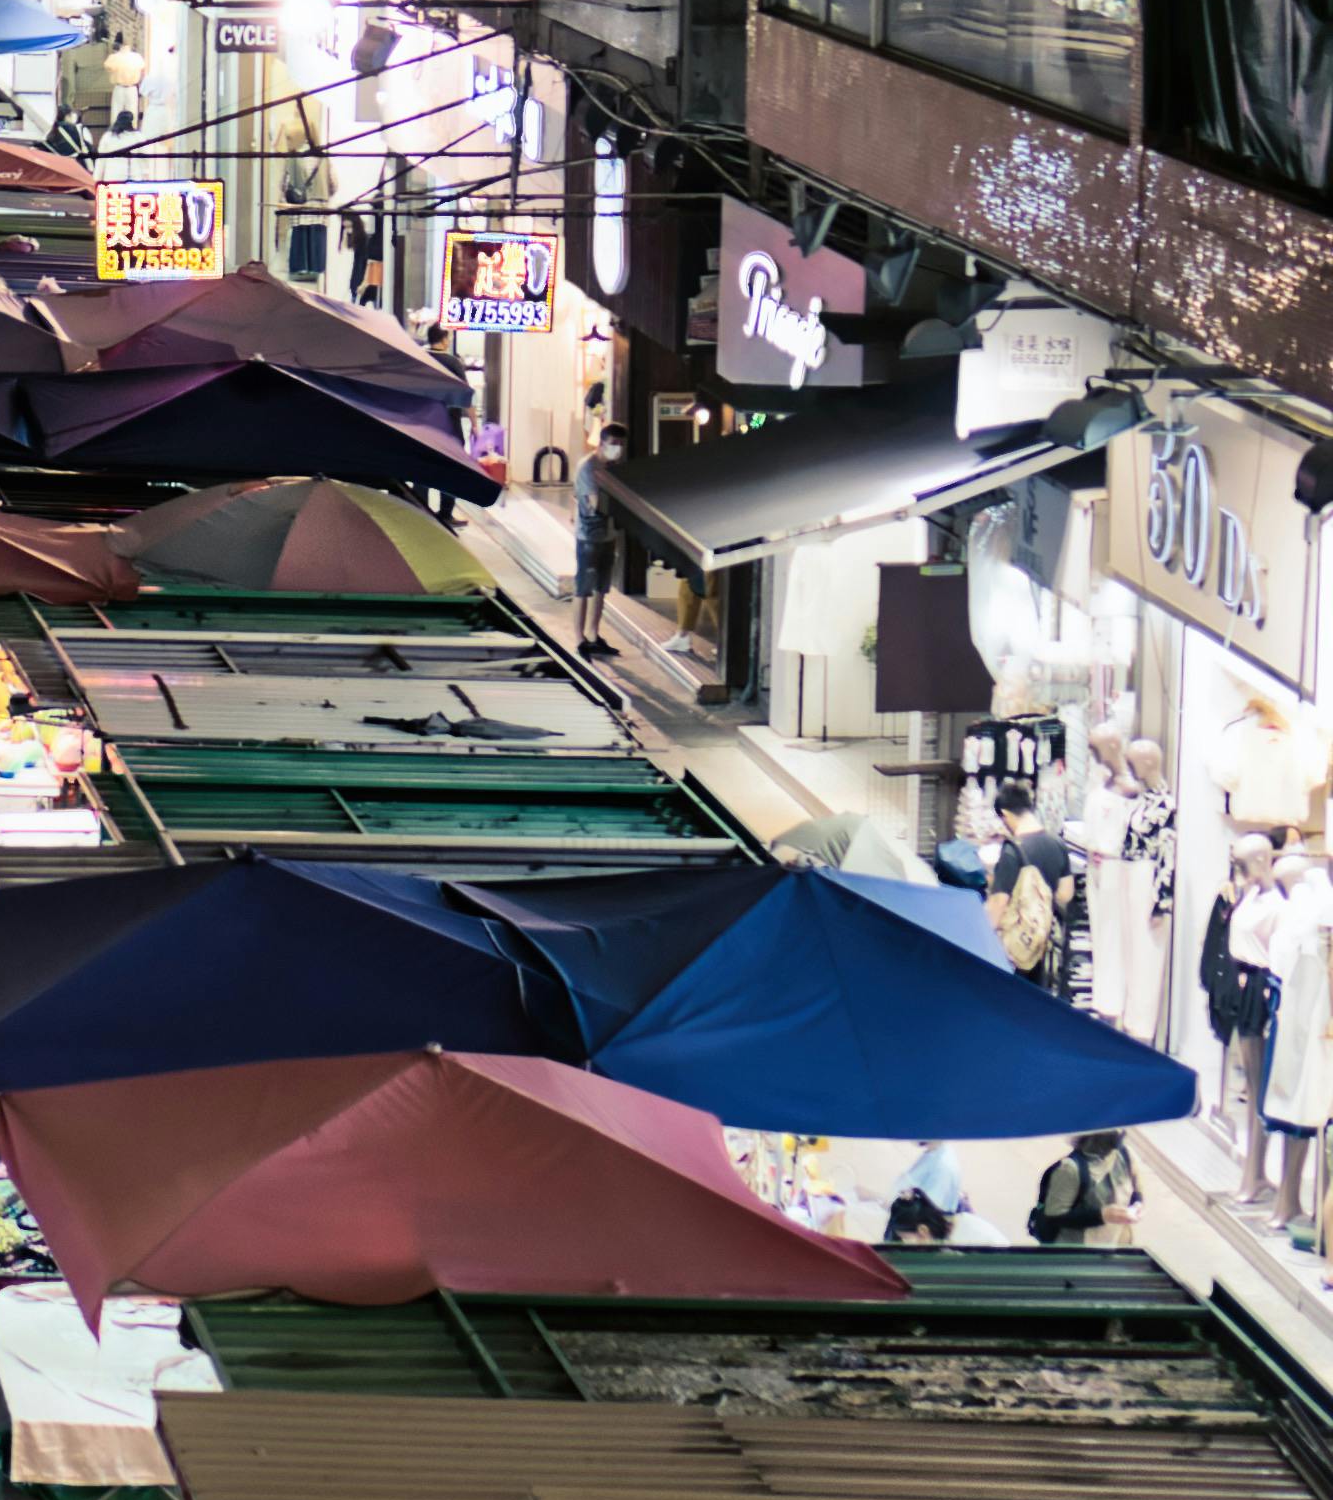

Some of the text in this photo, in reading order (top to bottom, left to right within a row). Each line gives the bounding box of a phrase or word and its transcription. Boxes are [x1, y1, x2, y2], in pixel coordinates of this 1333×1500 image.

[219, 24, 278, 47] CYCLE
[105, 249, 214, 271] 91755993
[447, 297, 547, 327] 91755993
